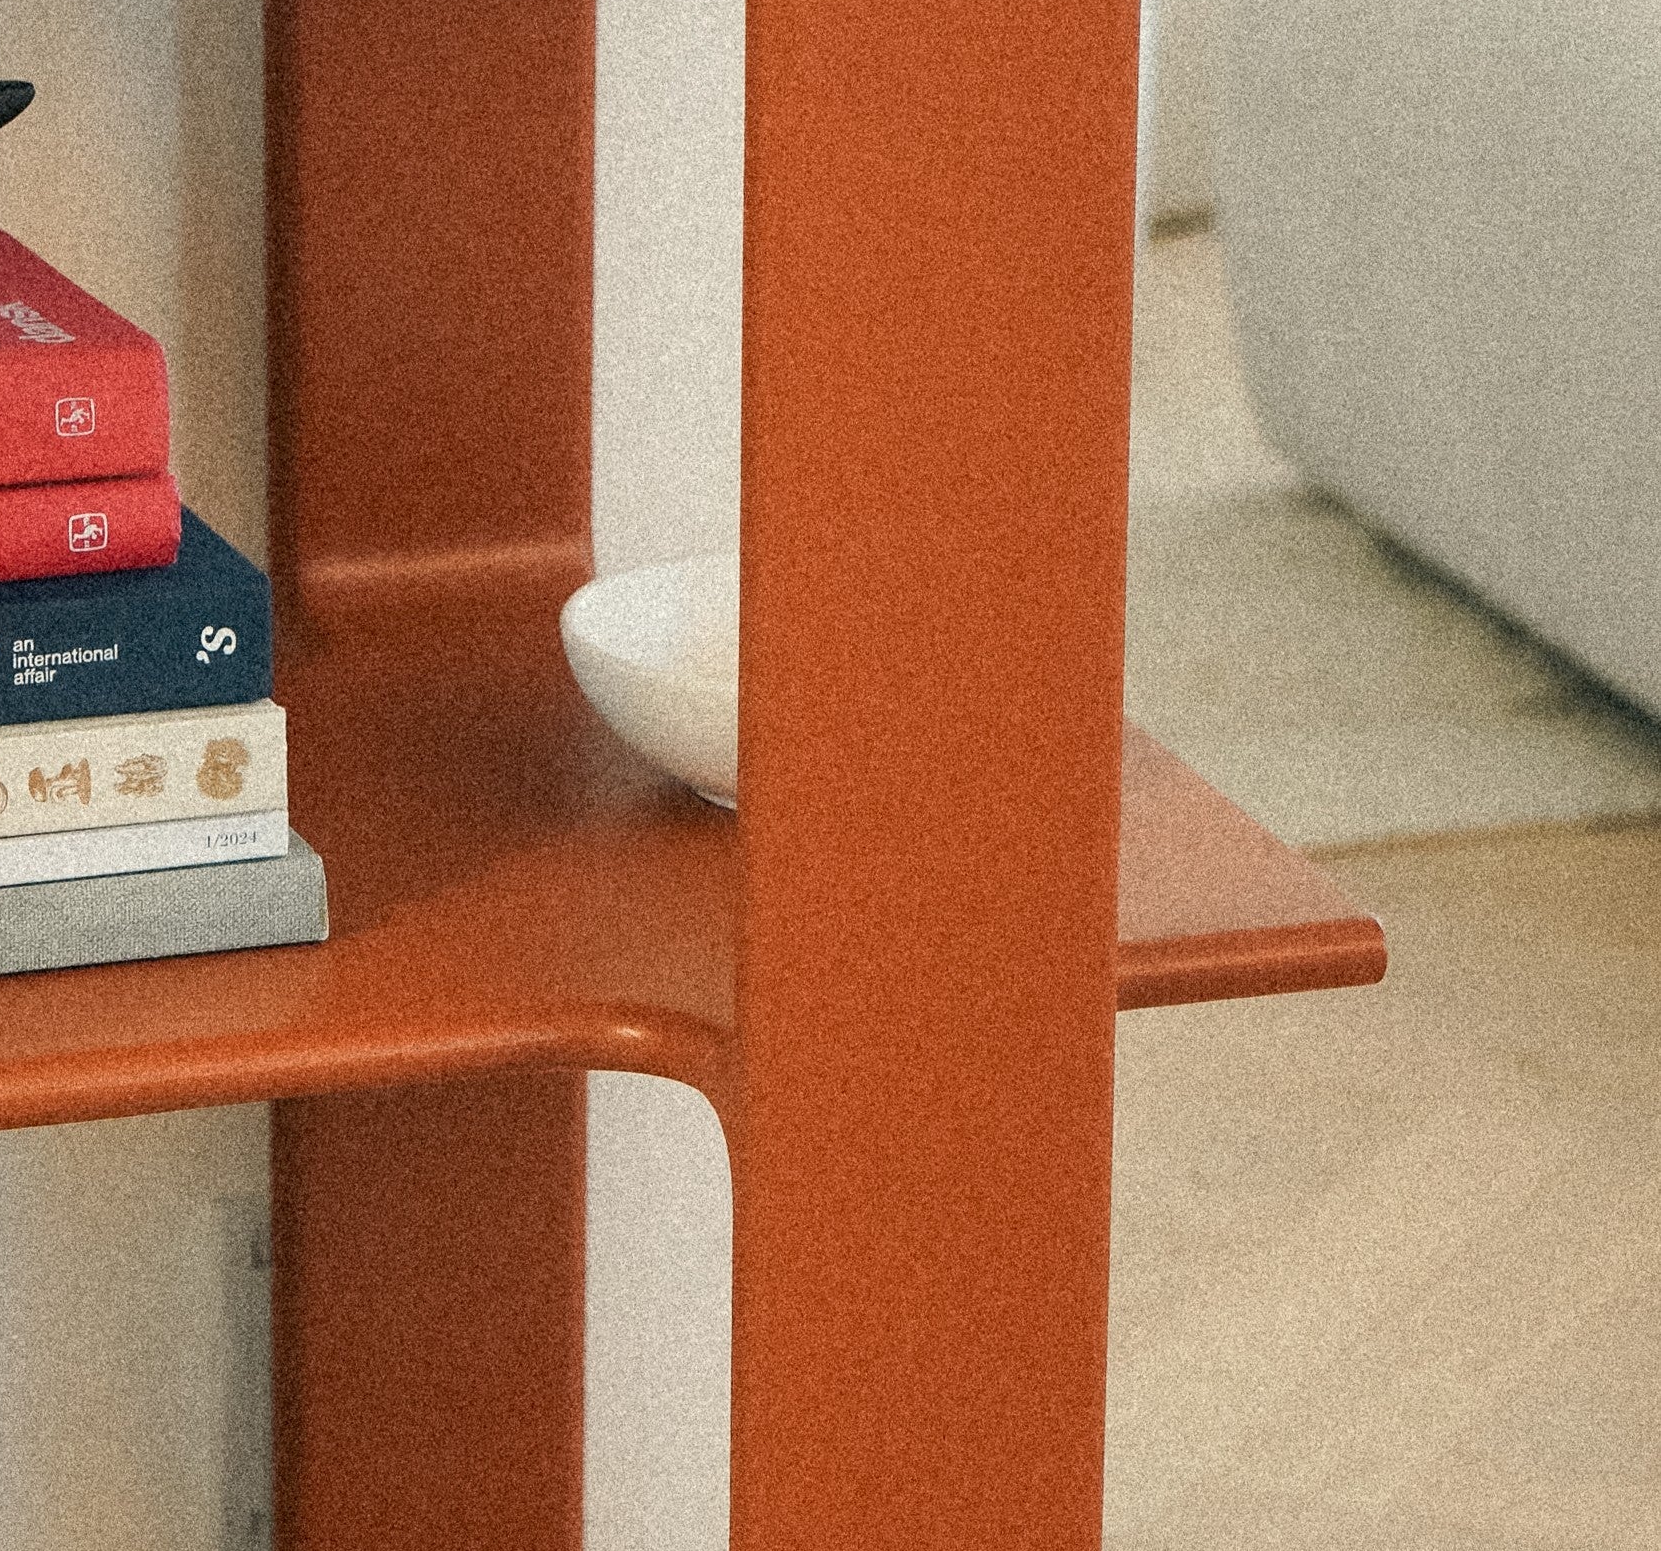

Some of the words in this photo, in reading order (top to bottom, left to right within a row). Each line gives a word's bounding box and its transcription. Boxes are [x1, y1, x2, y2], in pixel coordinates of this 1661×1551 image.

[12, 638, 35, 653] an
[12, 643, 119, 669] international
[13, 666, 57, 686] affair
[206, 830, 258, 849] 1/2024
